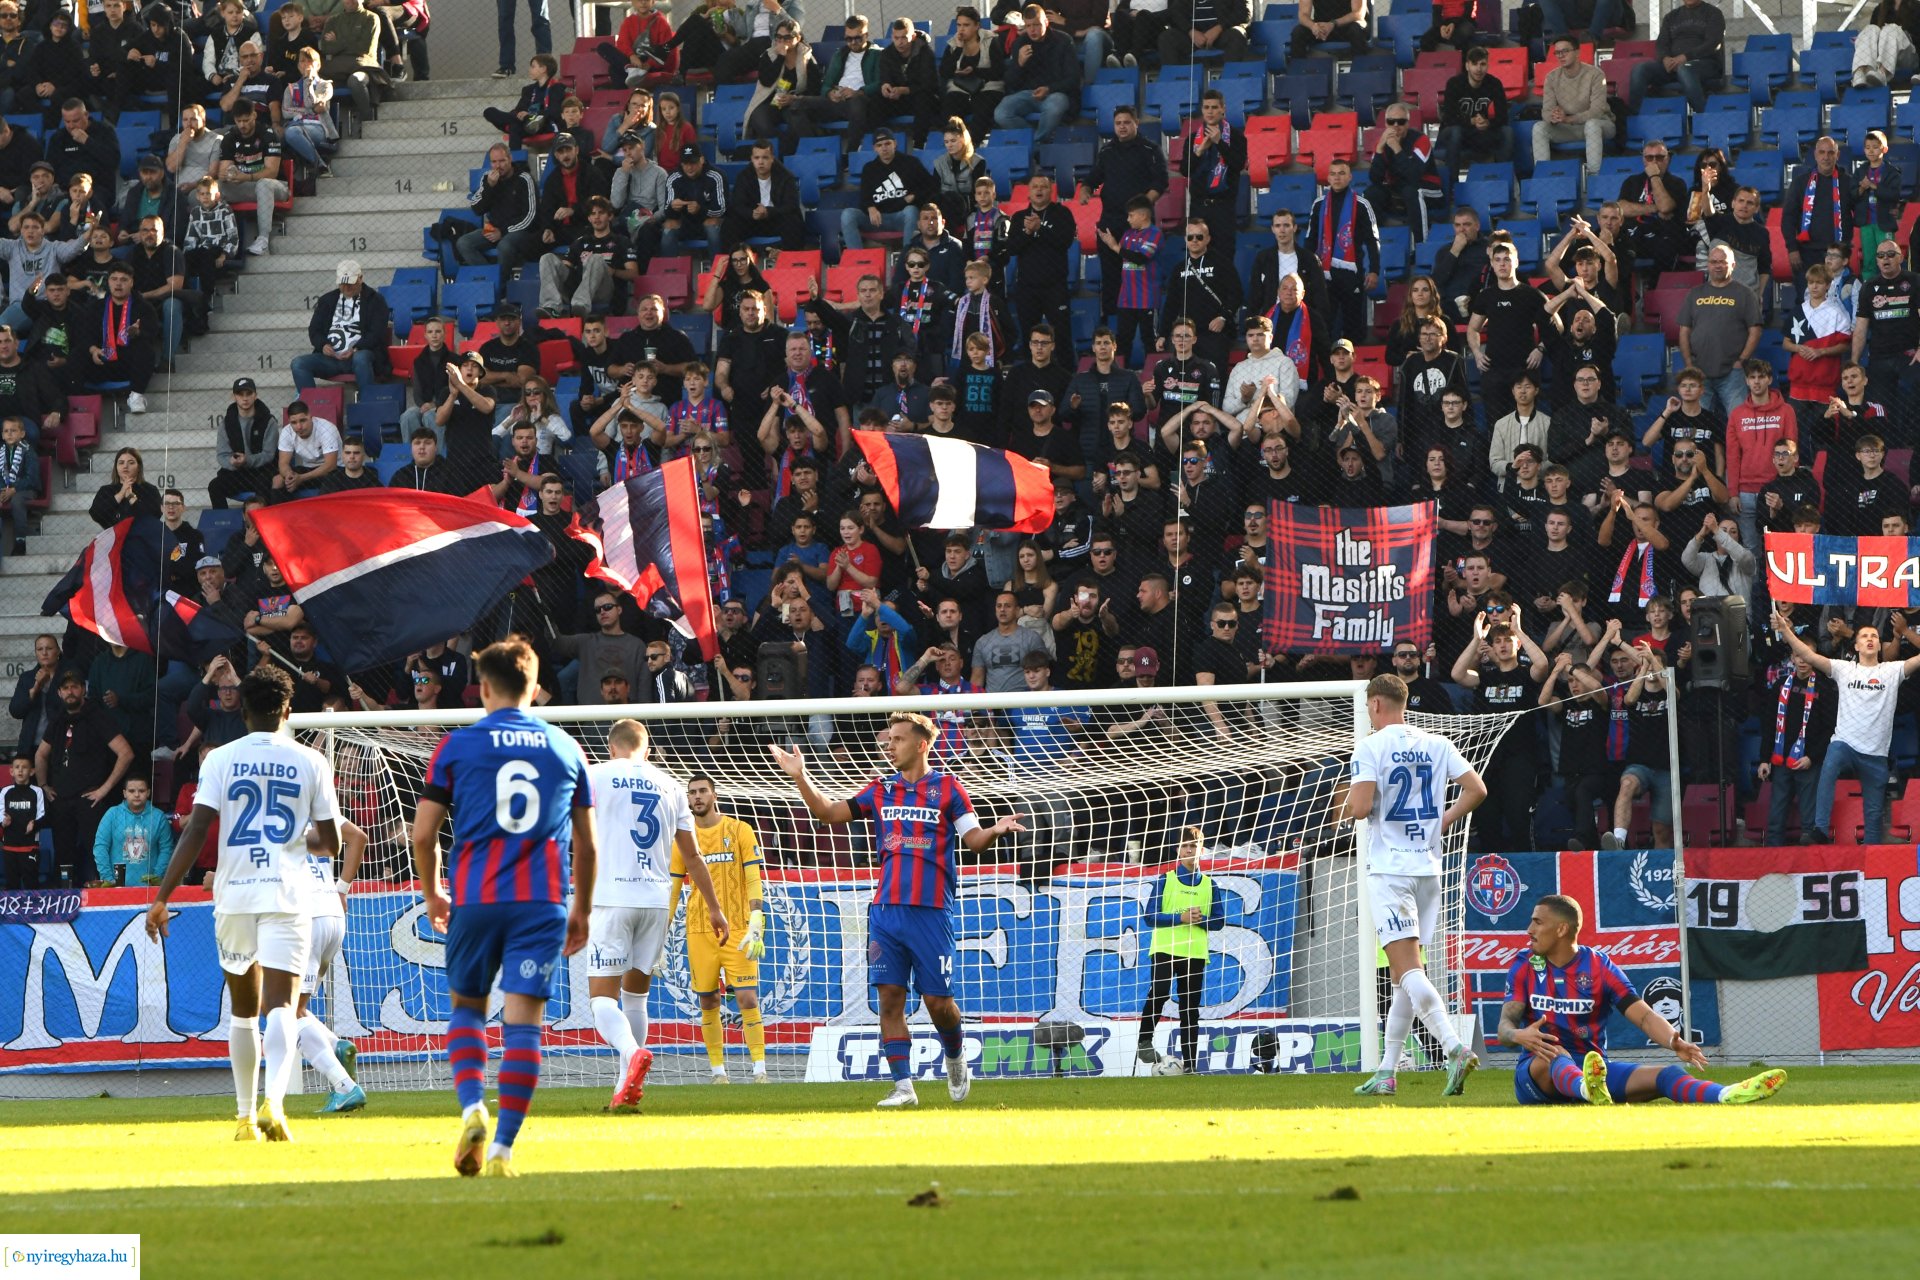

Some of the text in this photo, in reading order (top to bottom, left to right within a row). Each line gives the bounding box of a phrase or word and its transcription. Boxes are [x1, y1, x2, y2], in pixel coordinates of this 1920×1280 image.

[440, 122, 458, 135] 15
[394, 180, 412, 193] 14
[350, 238, 367, 251] 13
[1696, 295, 1735, 306] adidas
[257, 354, 273, 369] 11
[966, 374, 994, 384] NEW
[967, 385, 992, 400] 66
[965, 403, 993, 413] YORK
[1741, 416, 1781, 425] TOM TAILOR
[158, 475, 176, 489] 09
[1336, 528, 1371, 566] the
[1767, 551, 1920, 591] ULTRA
[1301, 563, 1405, 603] Mastiffs
[1312, 602, 1395, 647] Family
[6, 662, 25, 677] 06
[1847, 679, 1886, 691] ellesse
[1022, 714, 1049, 722] UNIBET
[490, 730, 547, 748] TOMA
[1391, 748, 1433, 763] CSÓKA
[233, 763, 298, 780] IPALIBO
[496, 760, 540, 834] 6
[1385, 765, 1440, 821] 21
[227, 779, 301, 847] 25
[630, 791, 661, 849] 3
[704, 853, 734, 864] PMIX
[228, 877, 256, 886] PELLET
[1687, 872, 1860, 927] 19 56
[938, 955, 953, 975] 14
